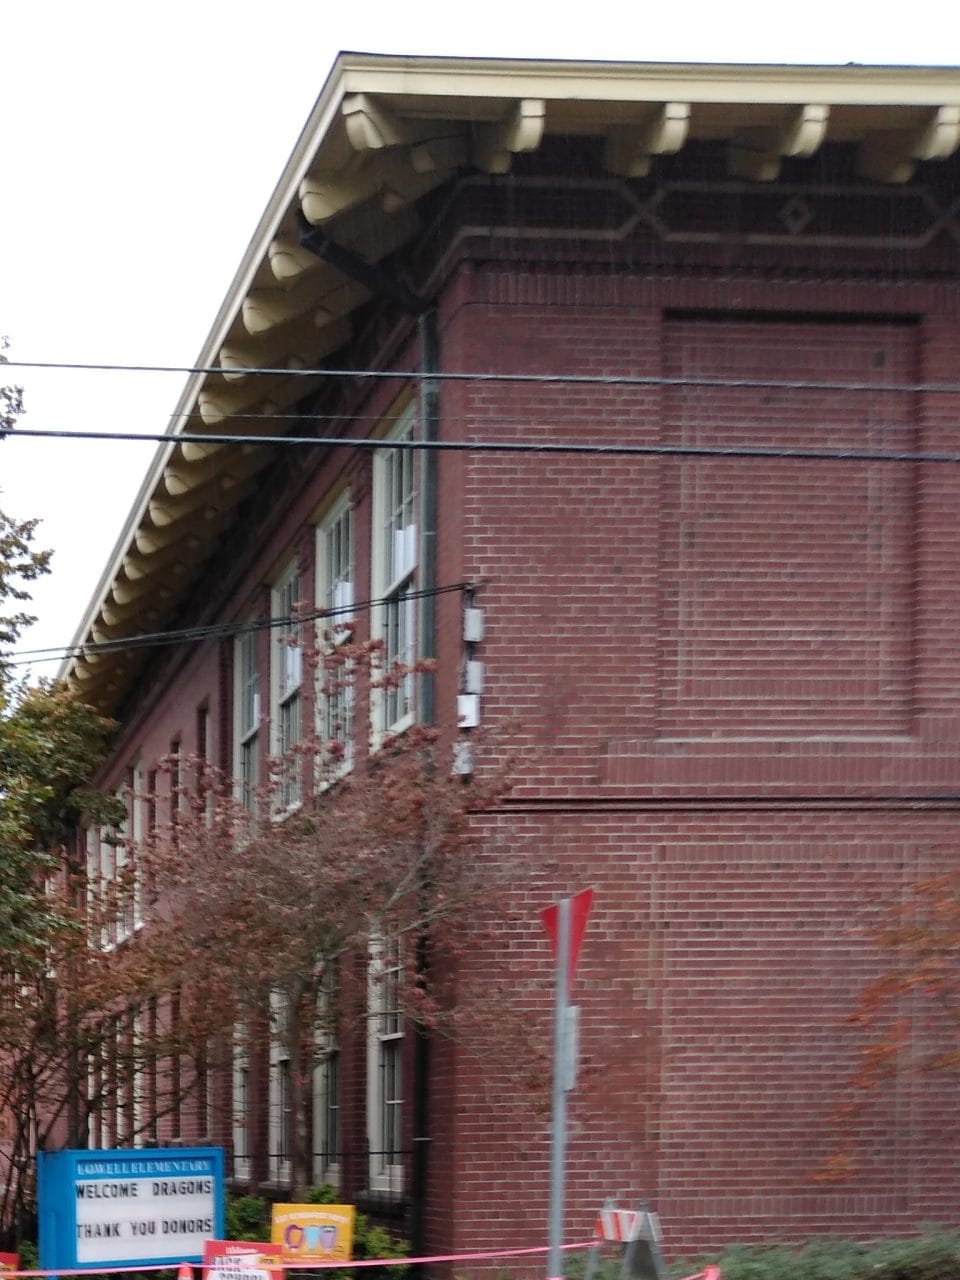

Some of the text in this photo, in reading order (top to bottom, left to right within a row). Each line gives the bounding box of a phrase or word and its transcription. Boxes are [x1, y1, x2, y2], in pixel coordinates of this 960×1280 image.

[77, 1160, 210, 1175] LOWELL ELEMENTARY
[75, 1180, 211, 1199] WELCOME DRAGONS
[77, 1219, 212, 1239] THANK YOU DONORS
